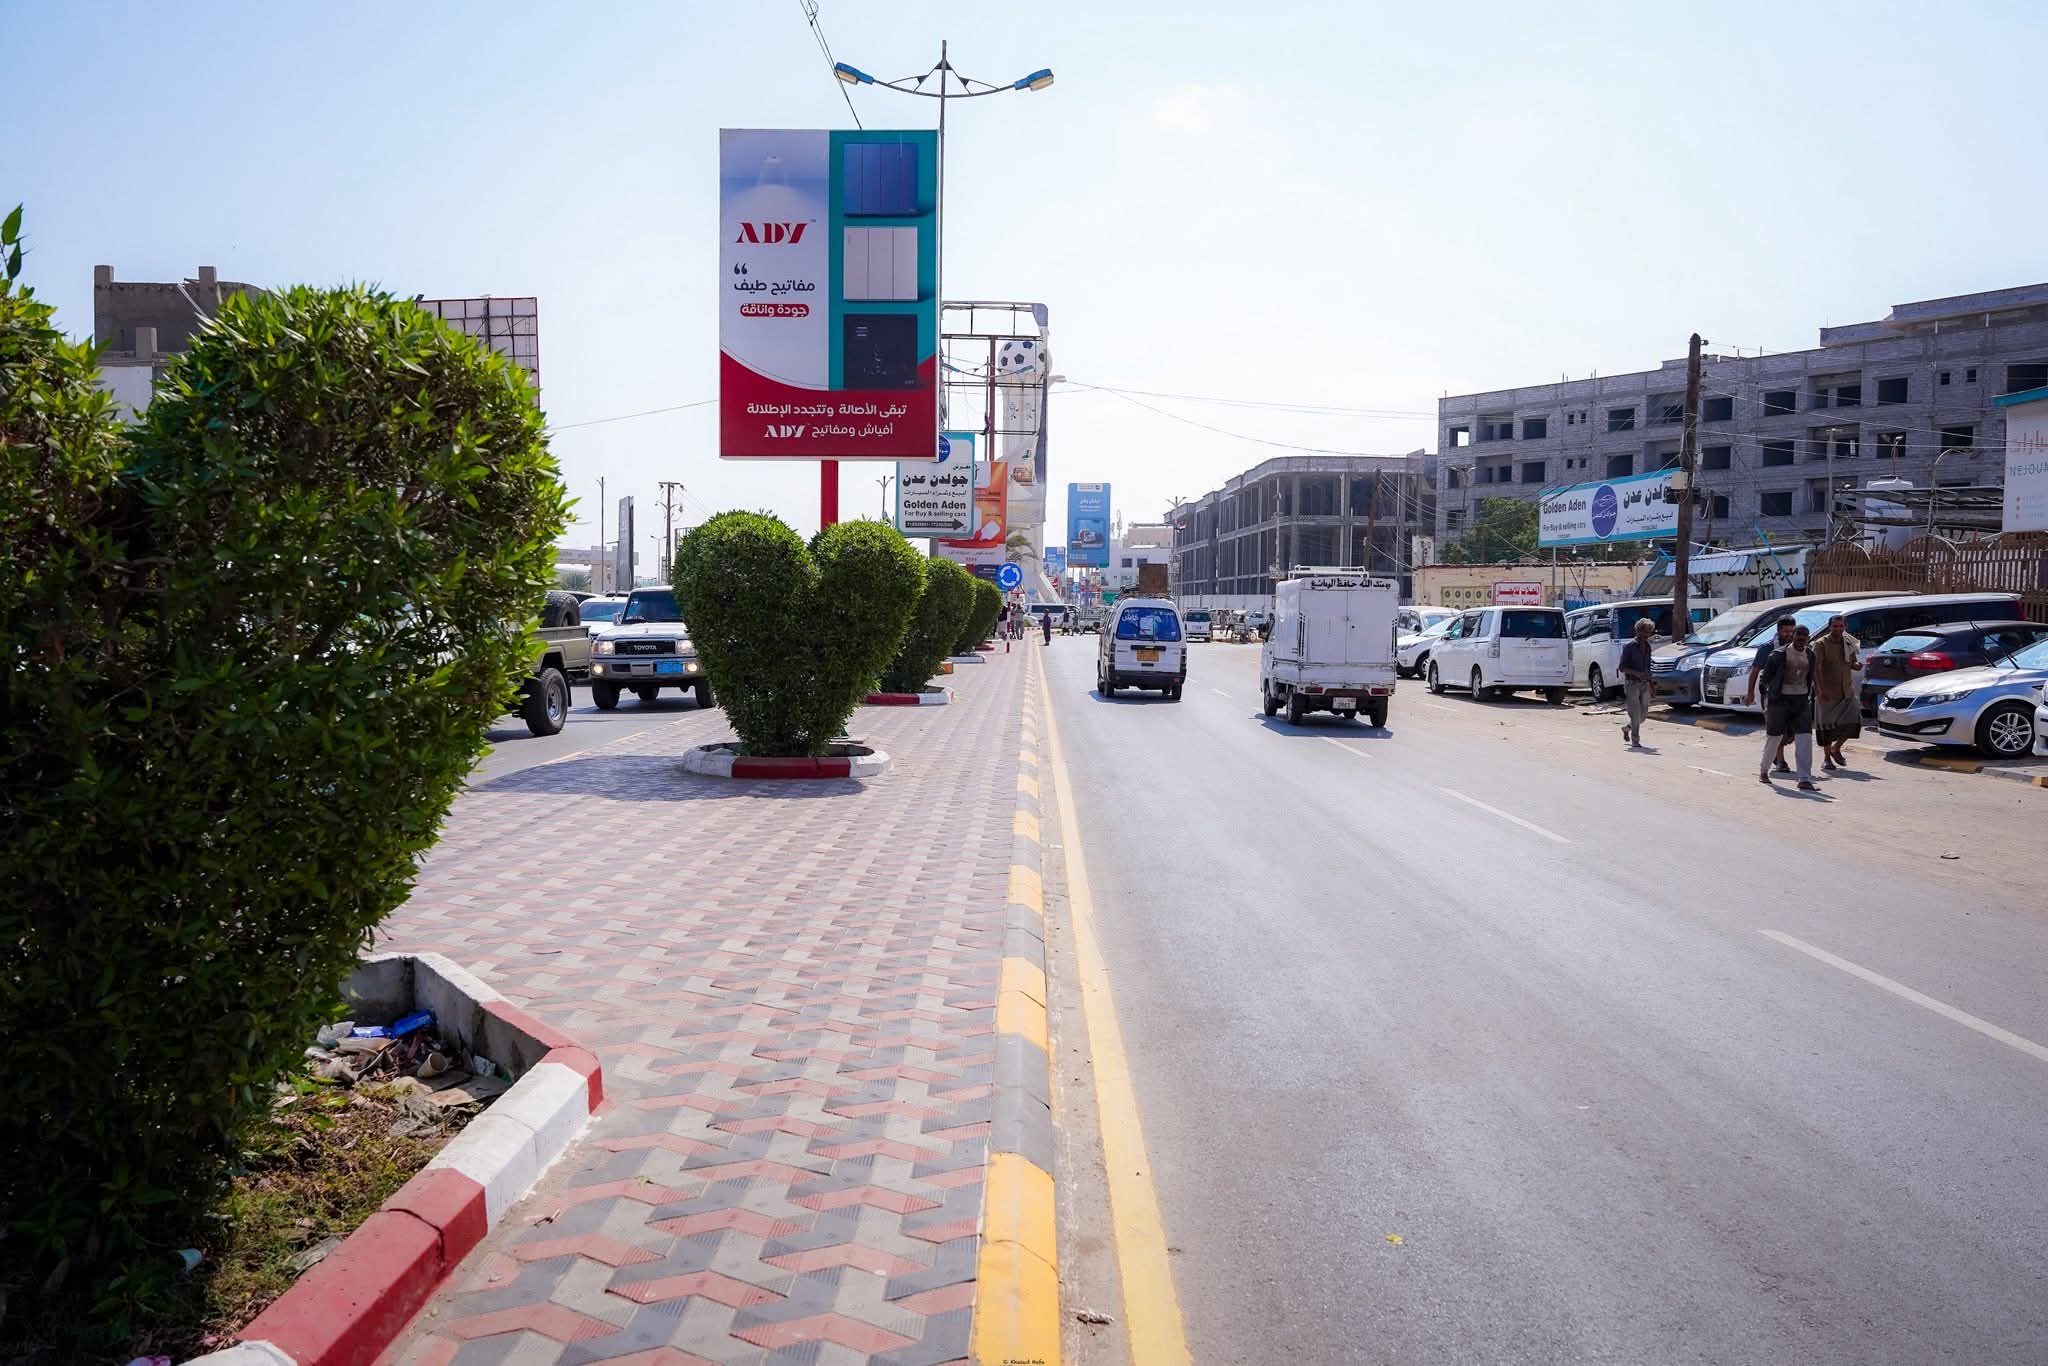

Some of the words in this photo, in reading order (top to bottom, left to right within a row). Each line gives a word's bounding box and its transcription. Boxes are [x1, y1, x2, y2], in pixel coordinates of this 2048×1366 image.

[733, 279, 768, 295] طيف
[770, 279, 816, 296] مفاتيح
[741, 303, 775, 317] واناقة
[777, 303, 808, 318] جودة
[746, 402, 792, 418] الإطلالة
[794, 403, 835, 417] وتتجدد
[838, 402, 877, 416] الأصالة
[879, 403, 908, 418] تبقى
[811, 423, 856, 438] ومفاتيح
[857, 422, 894, 438] أفياش
[902, 474, 926, 488] عدن
[929, 473, 969, 488] جولدن
[903, 500, 939, 509] Golden
[941, 500, 967, 510] Aden
[1543, 501, 1567, 514] Golden
[1568, 499, 1587, 512] Aden
[1623, 490, 1642, 510] عدن
[933, 511, 954, 519] selling
